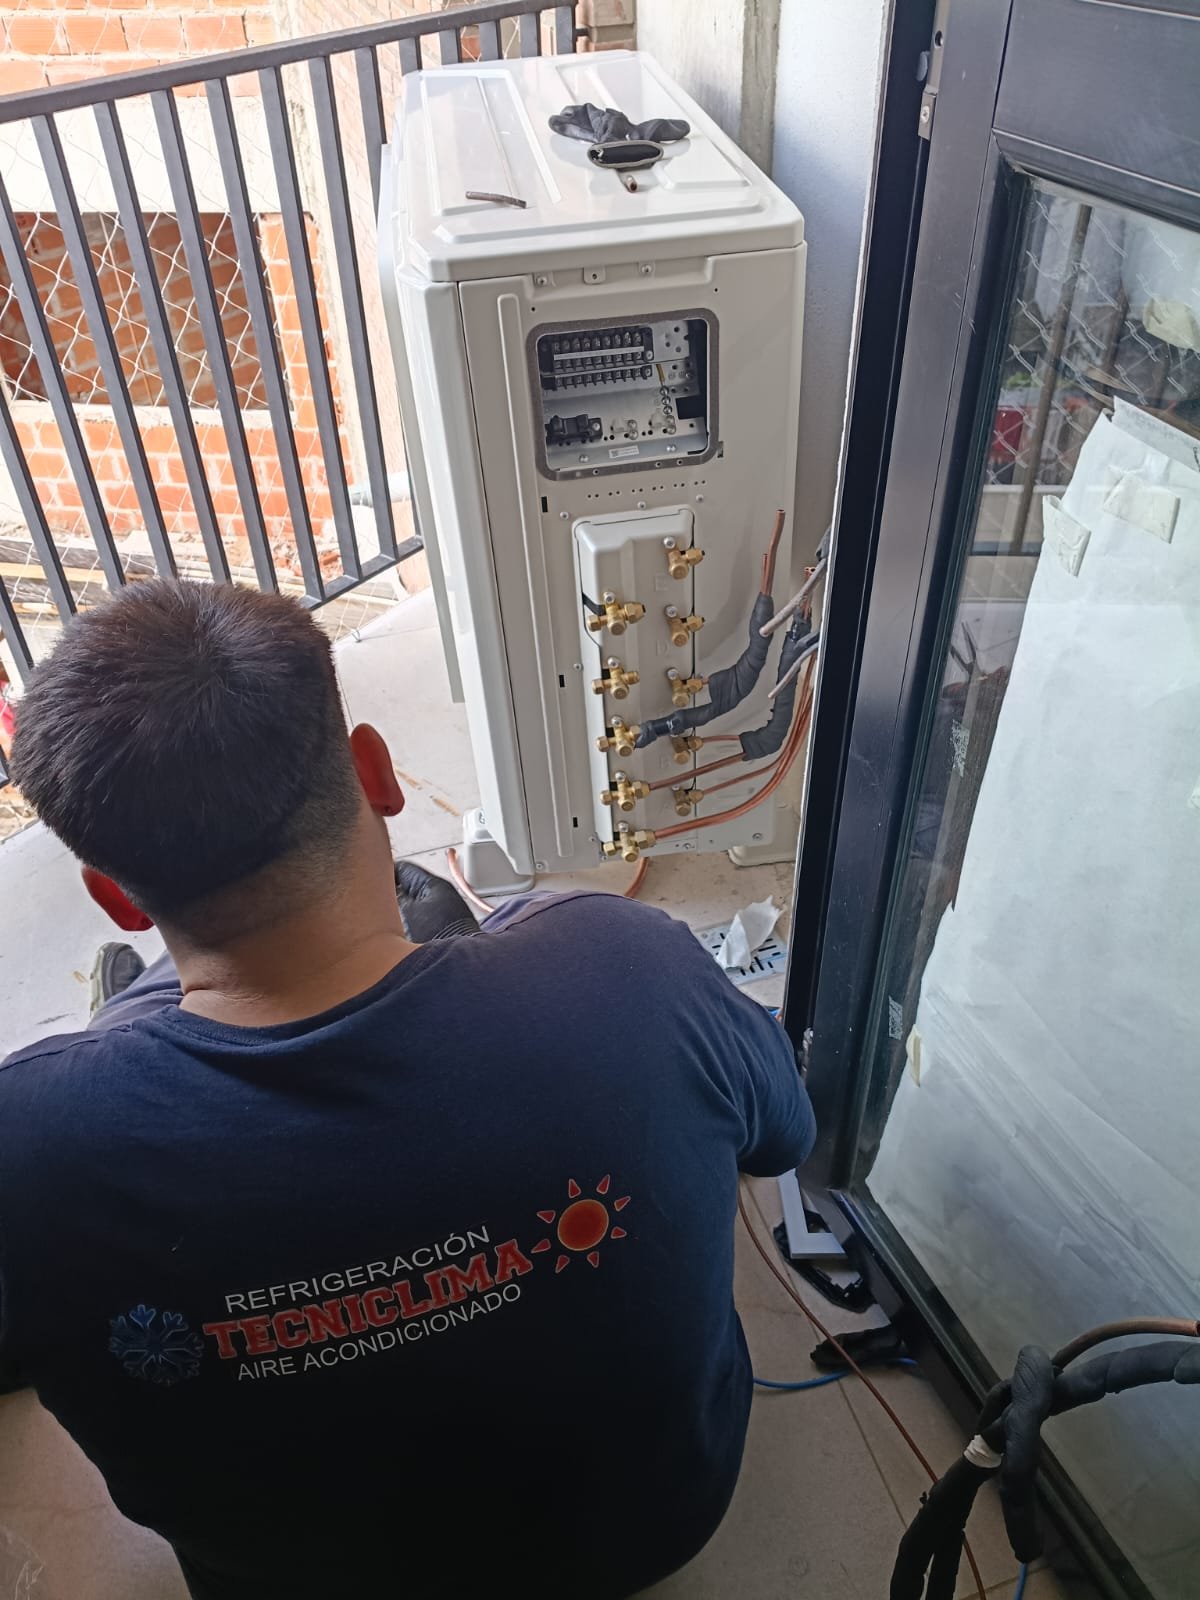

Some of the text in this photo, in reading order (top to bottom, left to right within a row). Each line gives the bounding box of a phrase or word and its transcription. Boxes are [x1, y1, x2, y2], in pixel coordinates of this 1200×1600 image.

[203, 1239, 533, 1359] TECNICLIMA
[225, 1225, 490, 1313] REFRIGERACIÓN
[238, 1284, 521, 1381] AIRE ACONDICIONADO
